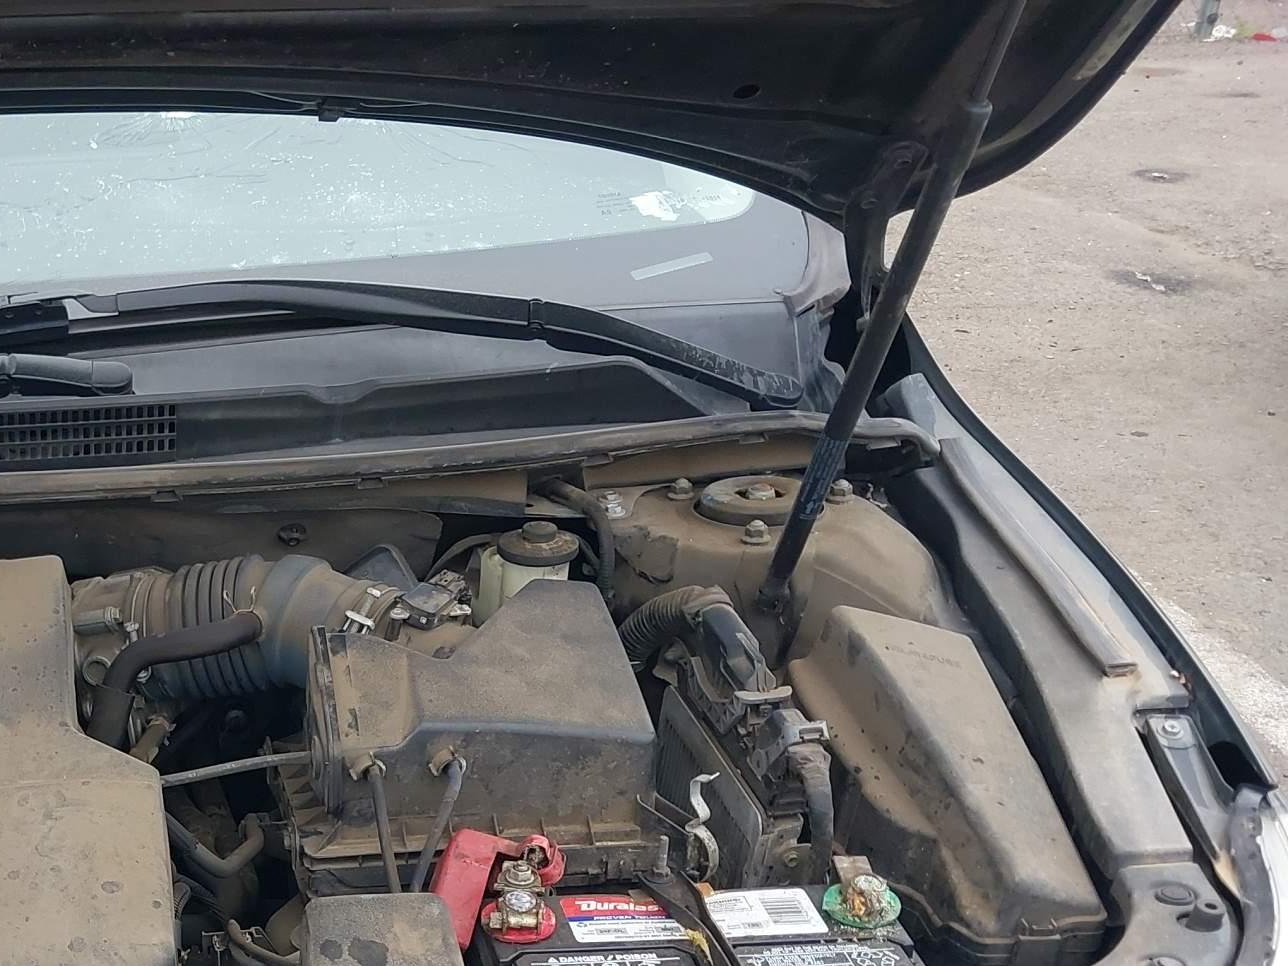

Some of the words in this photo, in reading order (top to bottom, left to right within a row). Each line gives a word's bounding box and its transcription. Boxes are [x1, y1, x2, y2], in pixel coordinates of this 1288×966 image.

[575, 900, 664, 912] Duralas
[558, 955, 604, 963] DANGER
[615, 953, 658, 961] POISON
